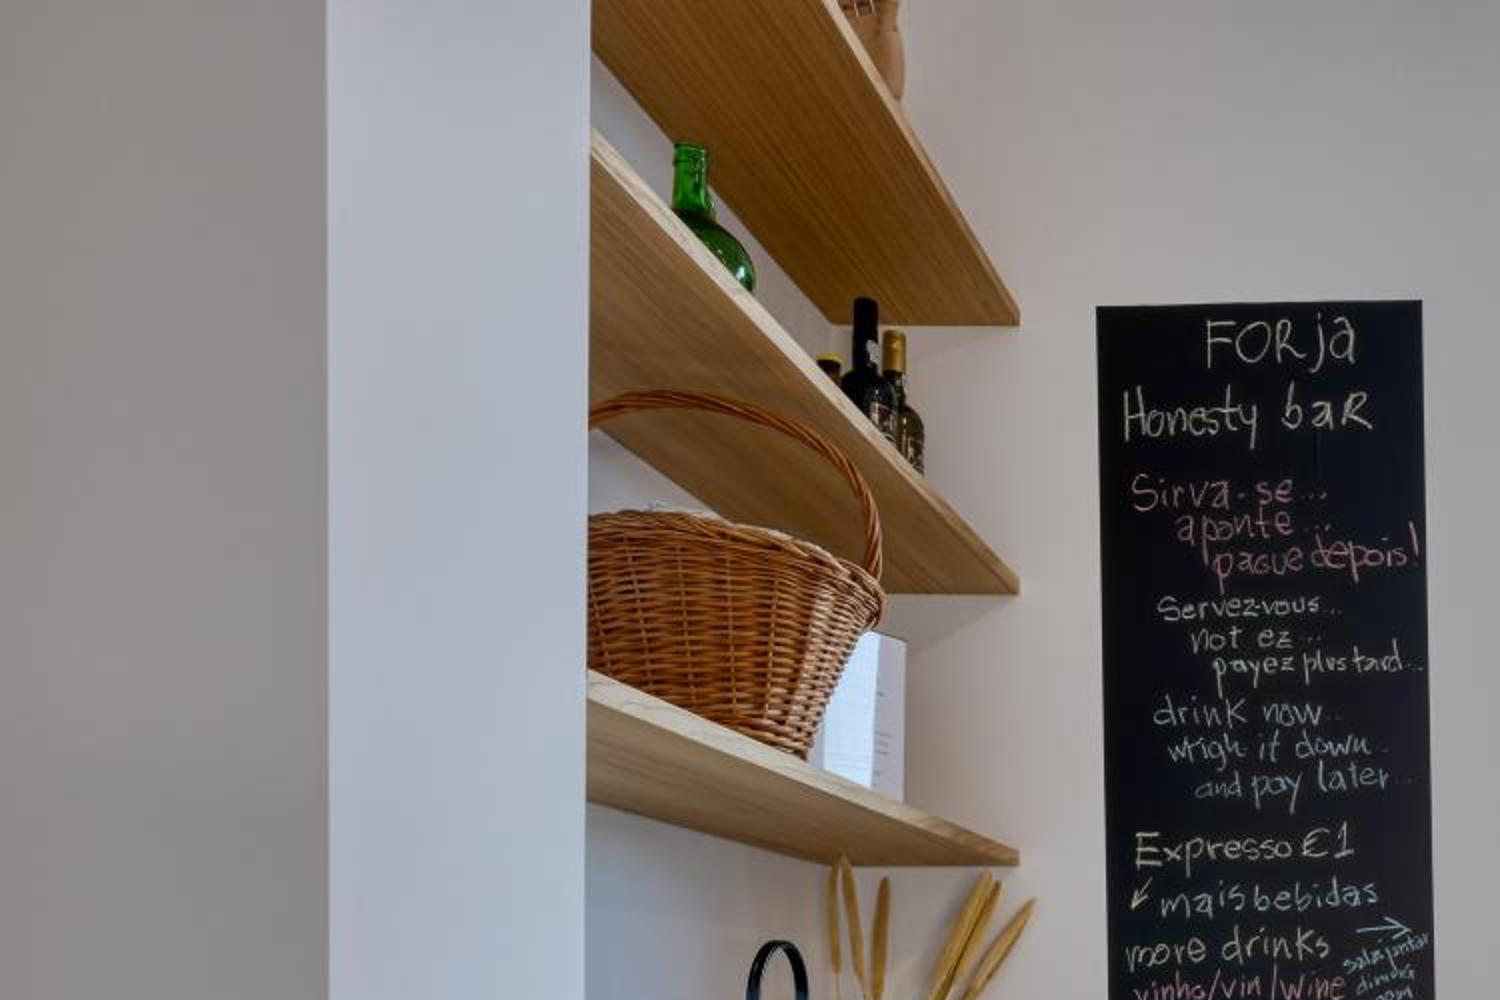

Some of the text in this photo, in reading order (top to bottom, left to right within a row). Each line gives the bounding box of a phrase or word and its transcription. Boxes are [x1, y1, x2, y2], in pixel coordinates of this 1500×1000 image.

[1124, 383, 1258, 449] Honesty
[1212, 655, 1294, 699] payez
[1153, 695, 1247, 729] drink
[1259, 729, 1281, 763] it
[1195, 770, 1242, 799] and
[1250, 772, 1301, 814] pay
[1134, 831, 1294, 878] Expresso
[1160, 874, 1379, 919] mais bebidas
[1124, 924, 1330, 973] more drinks
